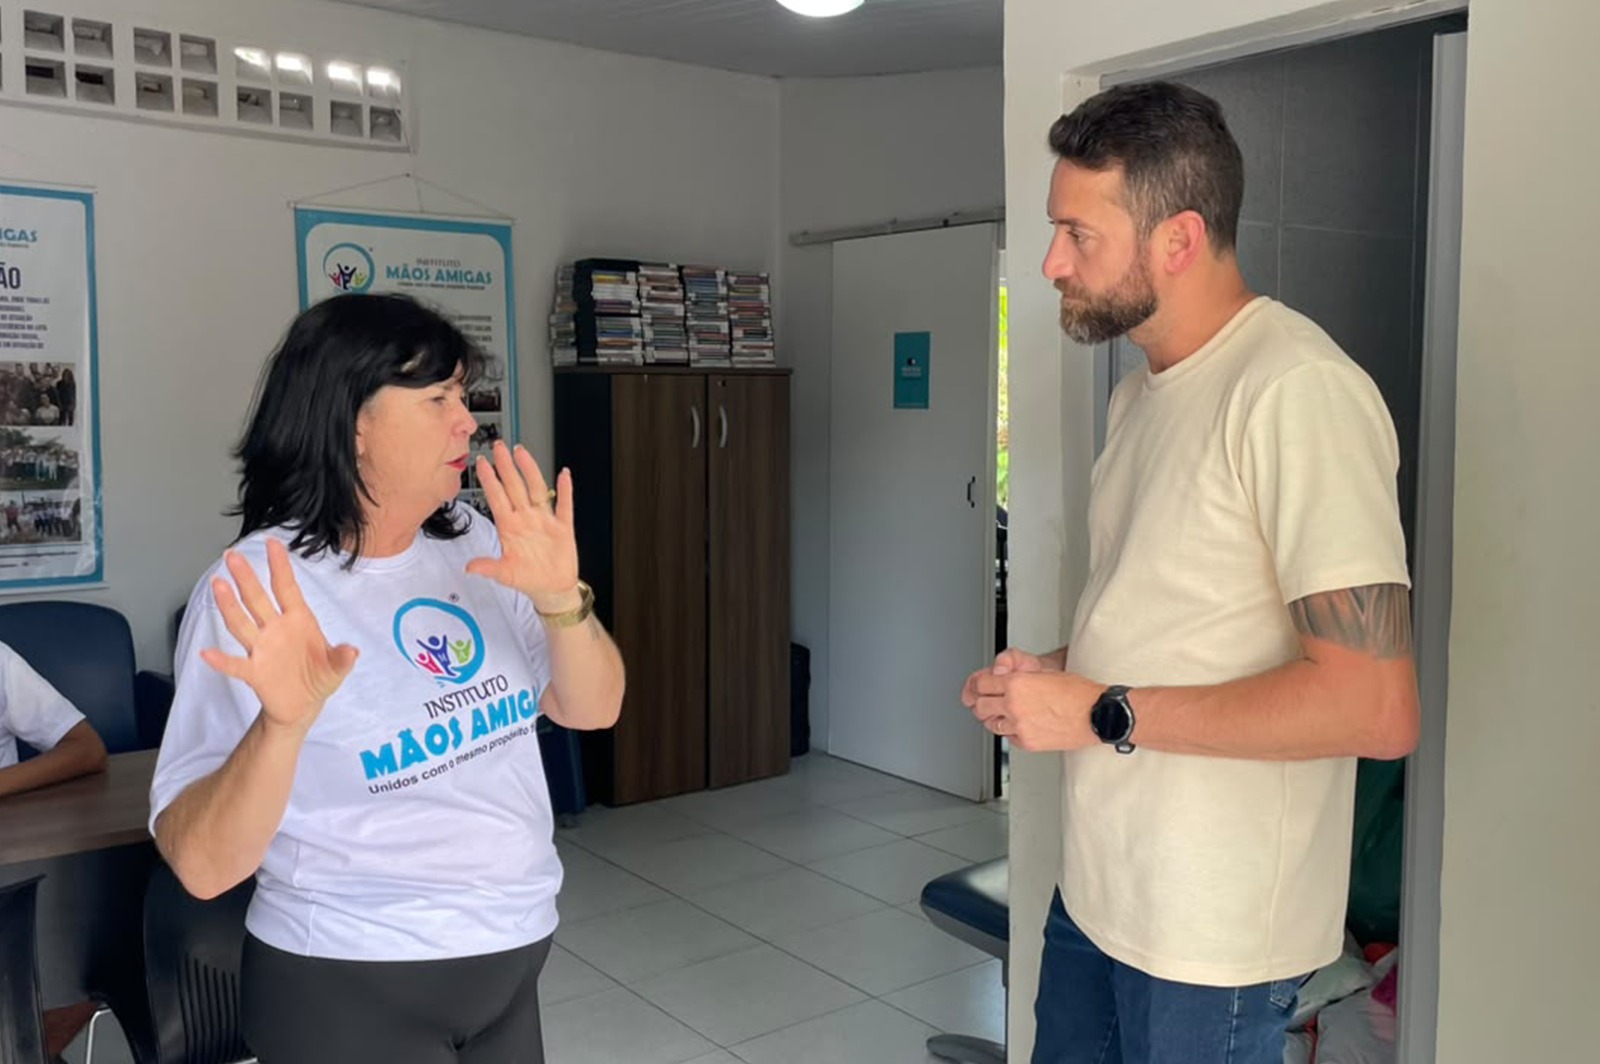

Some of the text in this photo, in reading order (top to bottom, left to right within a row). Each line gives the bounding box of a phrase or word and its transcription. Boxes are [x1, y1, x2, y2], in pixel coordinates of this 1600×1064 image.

[386, 264, 493, 285] MÃOS AMIGAS
[423, 674, 509, 719] INSTITUTO
[359, 716, 464, 781] MÃOS
[368, 775, 419, 794] Unidos
[421, 763, 449, 780] com
[448, 759, 455, 768] o
[455, 744, 488, 765] mesmo
